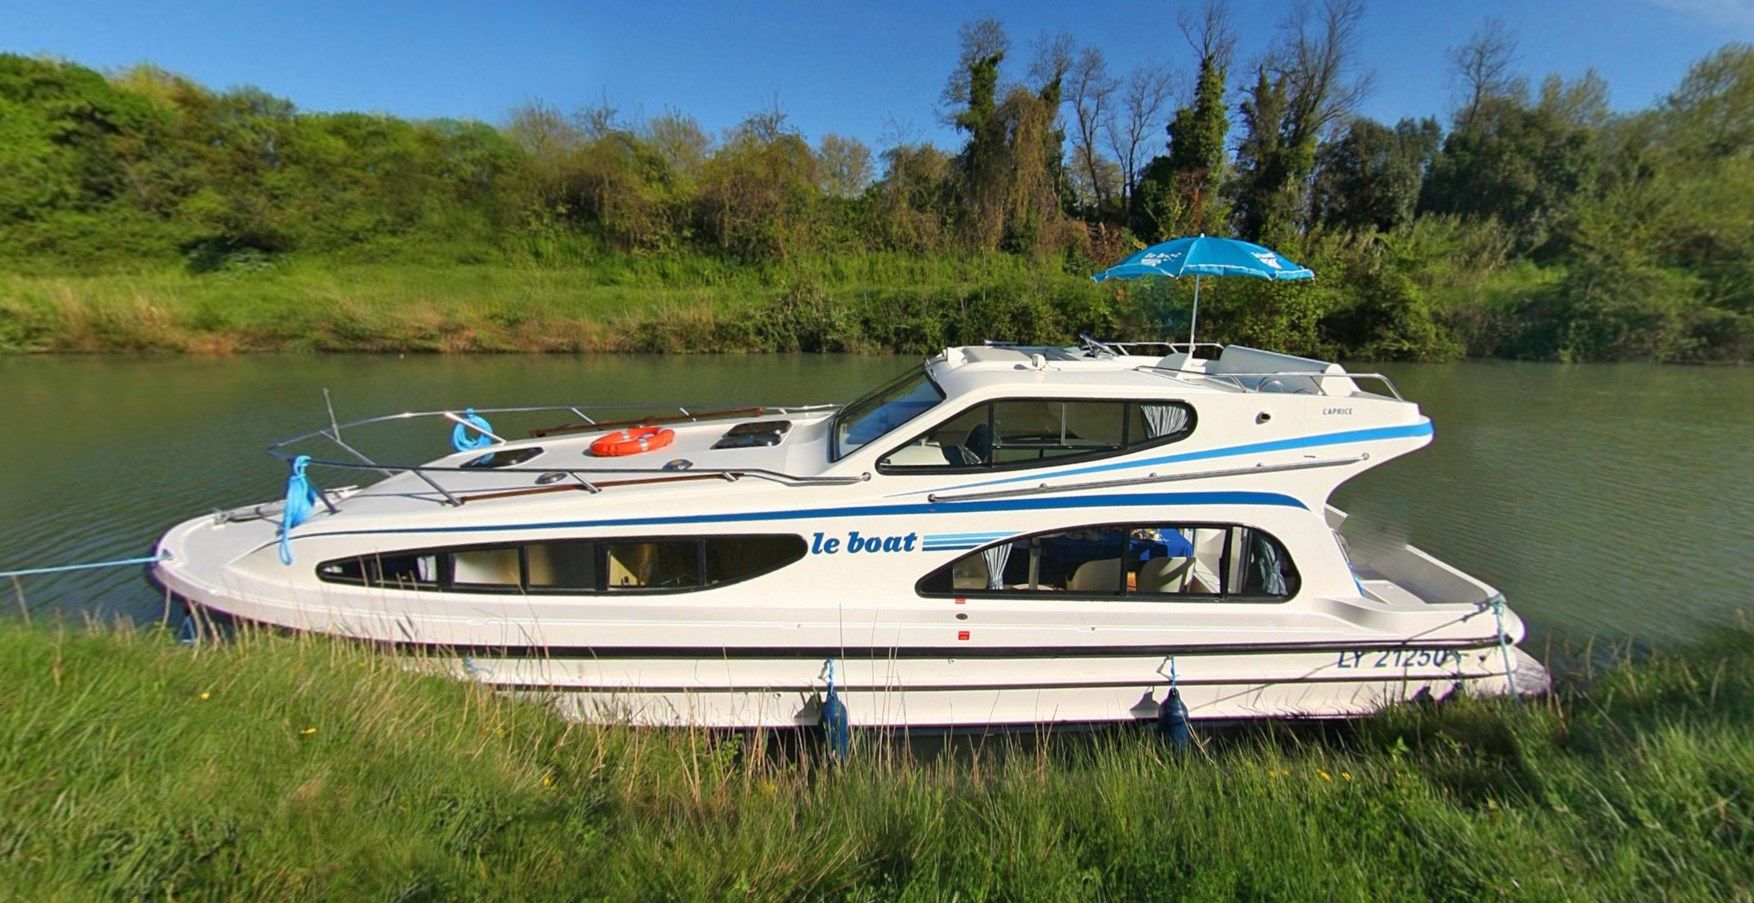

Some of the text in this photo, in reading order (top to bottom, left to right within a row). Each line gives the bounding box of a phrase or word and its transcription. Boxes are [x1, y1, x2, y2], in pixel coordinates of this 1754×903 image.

[1322, 407, 1353, 416] CAPRICE
[811, 531, 917, 555] le boat
[1337, 649, 1365, 668] LY
